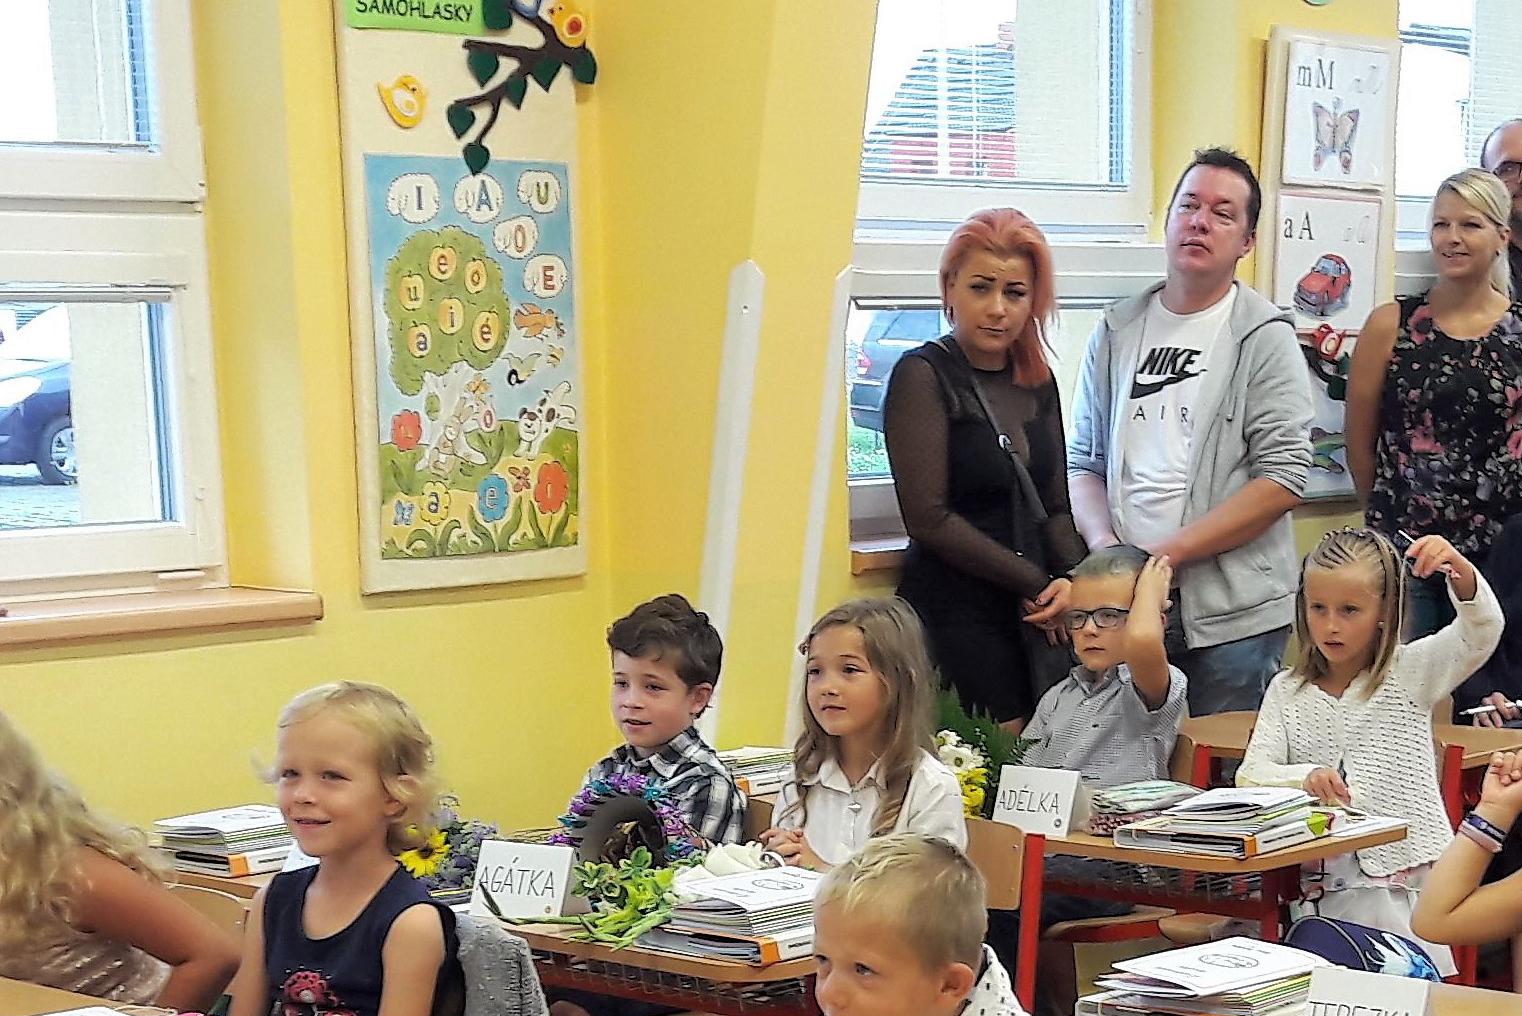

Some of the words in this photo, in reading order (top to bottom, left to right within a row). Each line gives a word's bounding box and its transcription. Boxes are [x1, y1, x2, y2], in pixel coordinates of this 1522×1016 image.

[476, 180, 494, 211] A
[542, 265, 555, 291] E
[1136, 347, 1203, 375] NIKE
[1133, 405, 1189, 423] AIR
[475, 856, 555, 898] AGÁTKA
